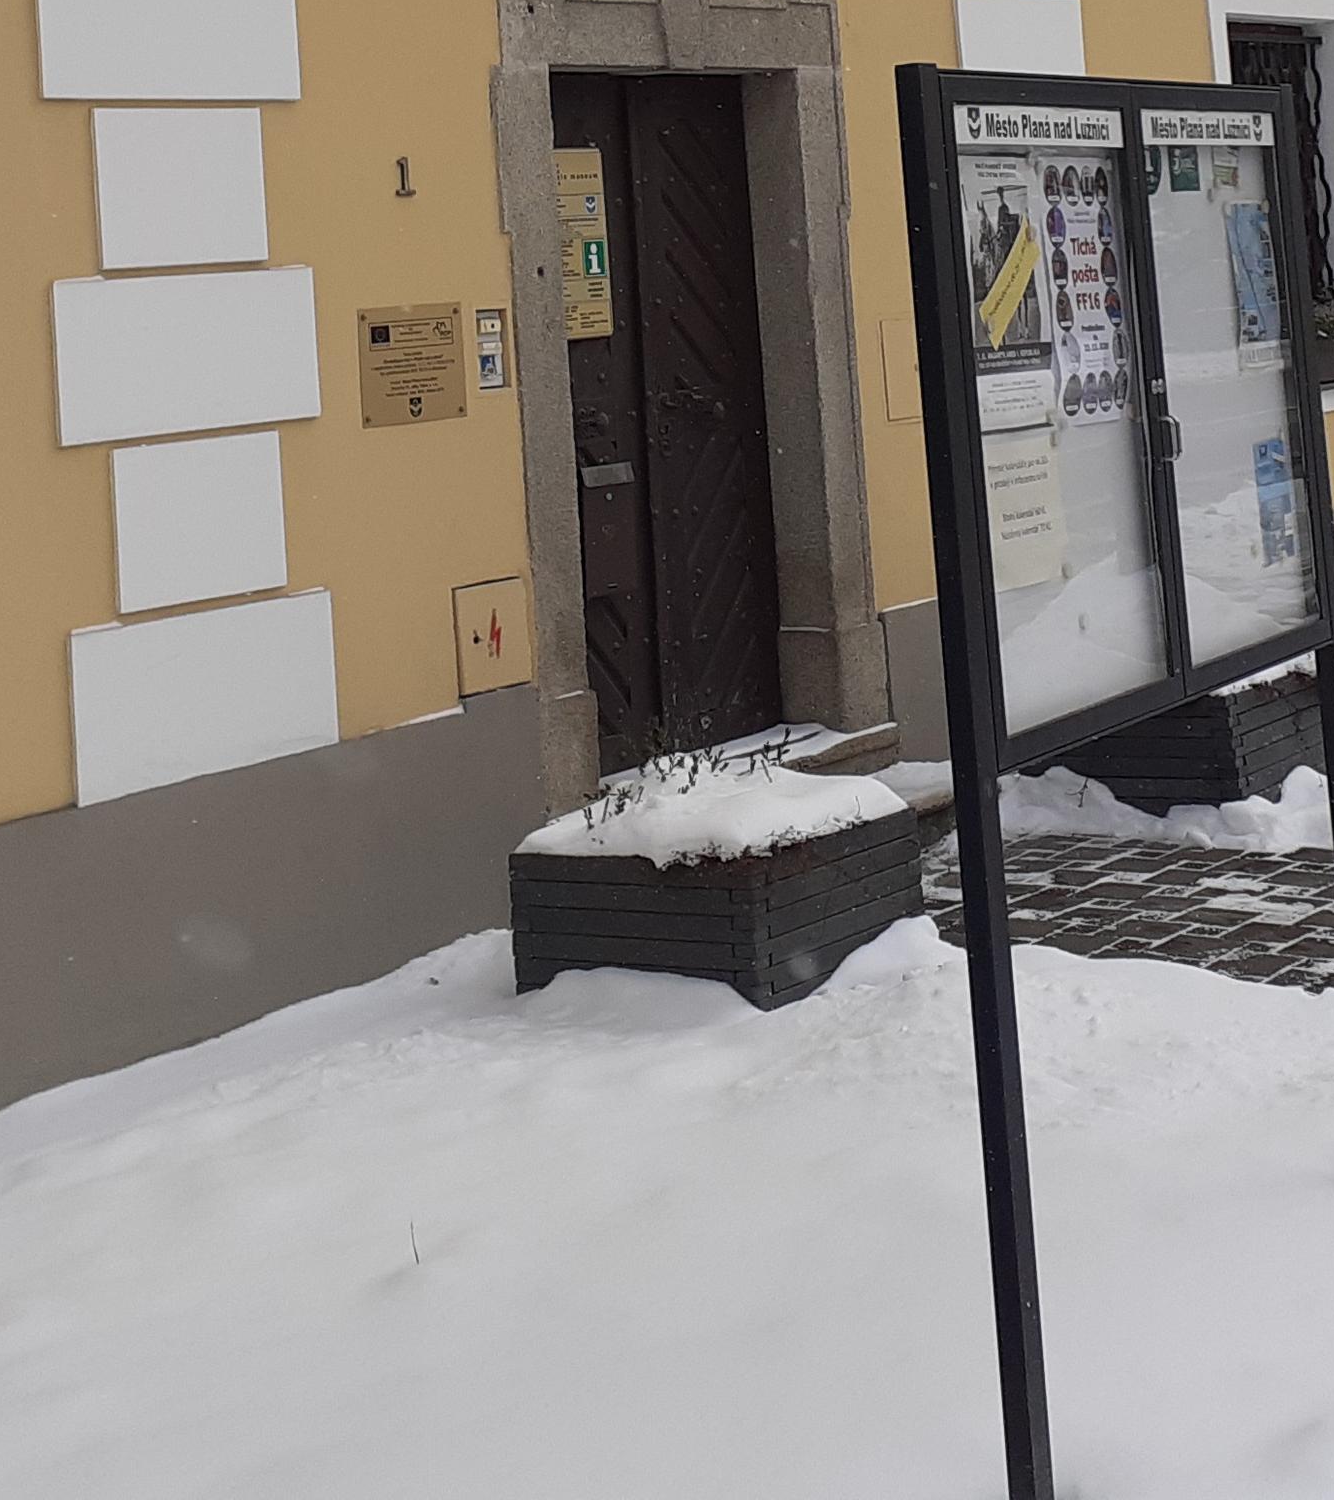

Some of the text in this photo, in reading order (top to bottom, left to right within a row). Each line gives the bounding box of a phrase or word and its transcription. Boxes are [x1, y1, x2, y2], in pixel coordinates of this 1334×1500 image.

[985, 112, 1018, 139] Město
[1021, 113, 1052, 139] Planá
[1054, 116, 1072, 140] nad
[1150, 115, 1178, 139] Město
[1179, 116, 1204, 140] Planá
[1205, 117, 1221, 140] nad
[395, 156, 417, 197] 1
[1069, 235, 1098, 256] Tichá
[1071, 263, 1100, 287] pošta
[1075, 292, 1101, 311] FF16
